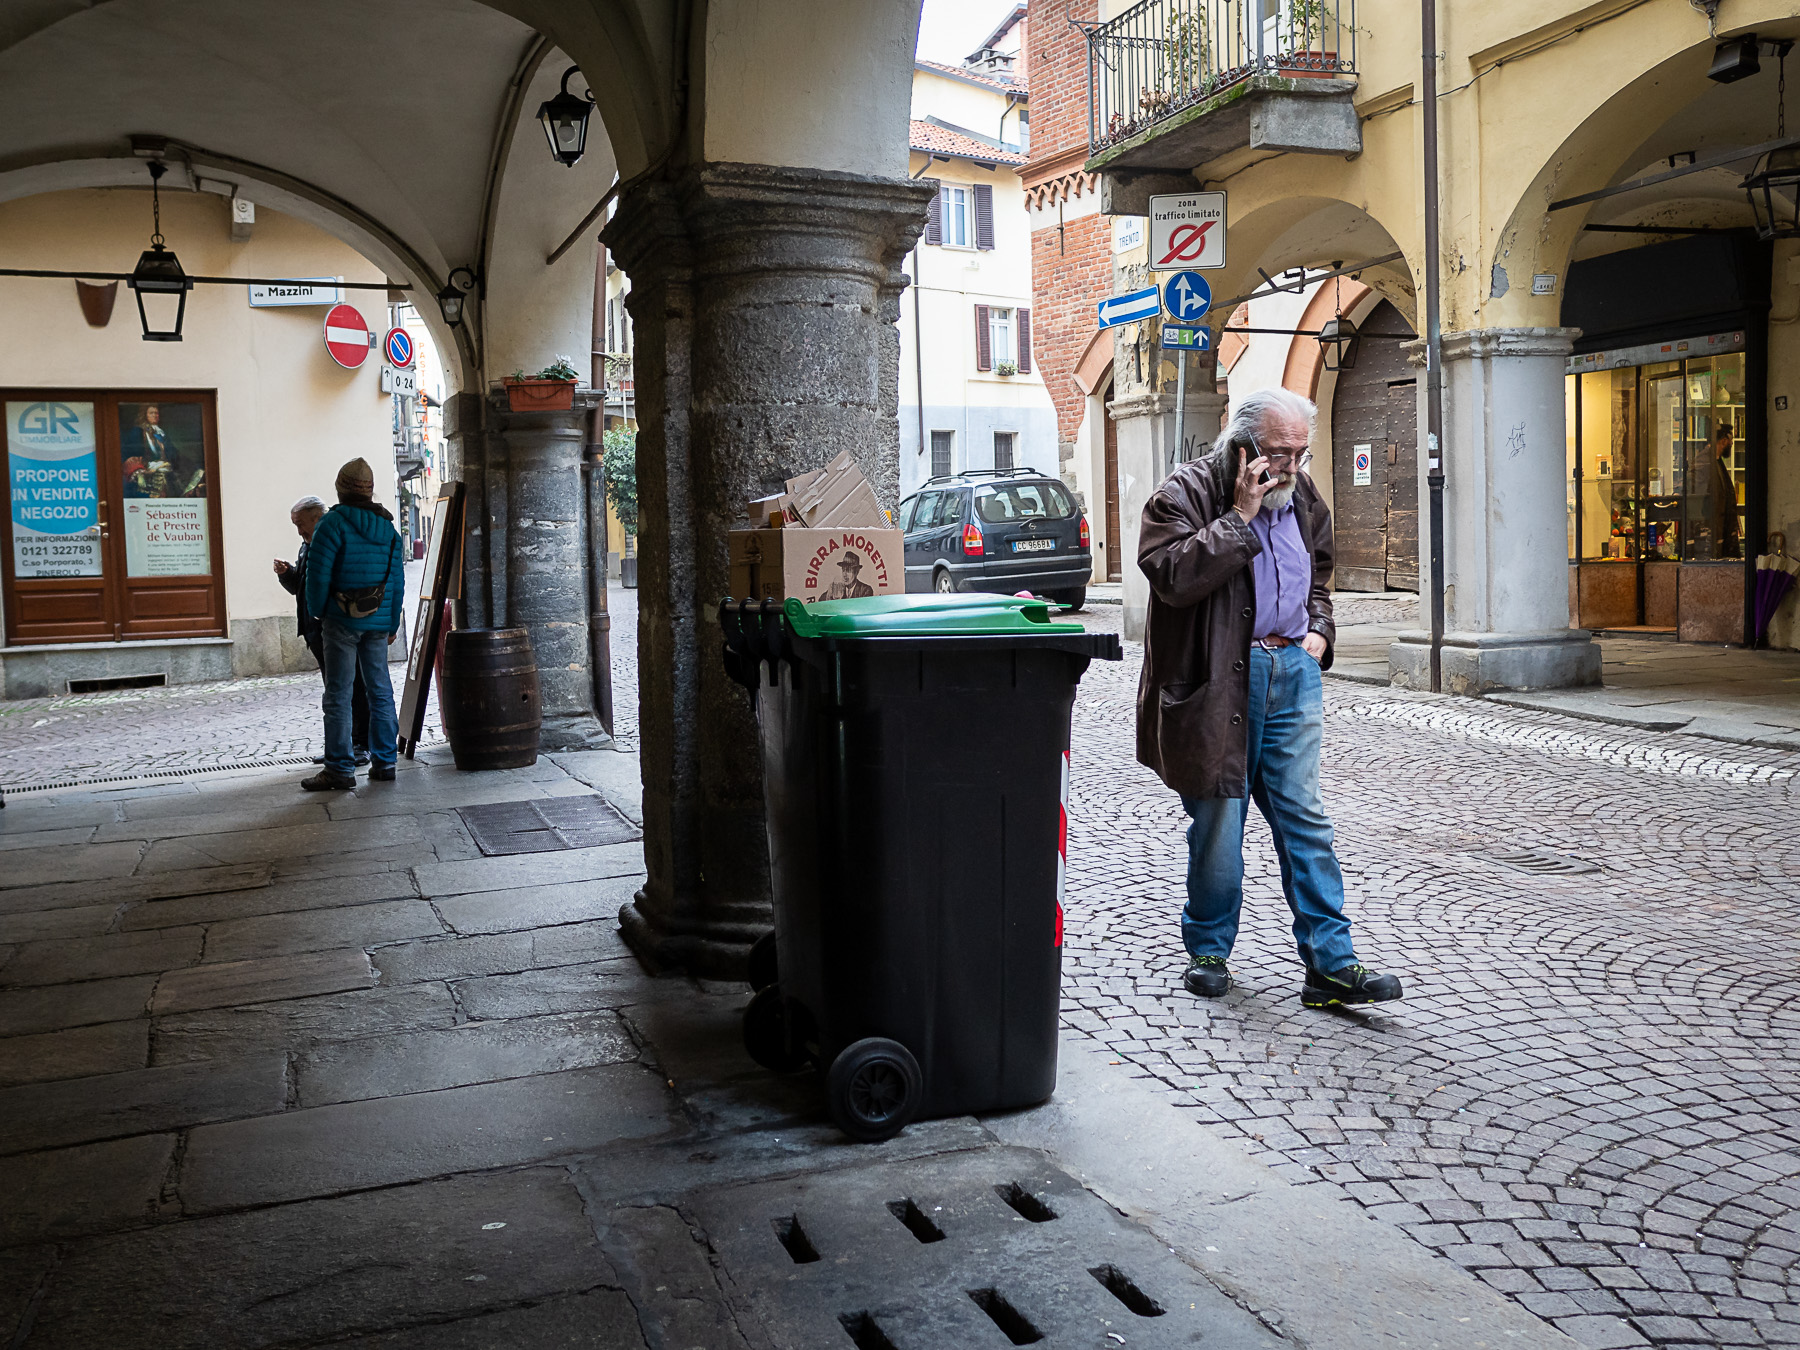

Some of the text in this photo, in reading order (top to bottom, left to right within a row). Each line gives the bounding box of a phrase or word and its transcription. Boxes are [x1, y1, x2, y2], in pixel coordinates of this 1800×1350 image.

[1178, 200, 1197, 208] zona
[1155, 210, 1221, 221] traffico limitato
[1119, 231, 1139, 248] TRENTO
[268, 286, 313, 297] Mazzini
[1182, 332, 1190, 344] 1
[18, 402, 79, 434] GR
[16, 469, 89, 482] PROPONE
[13, 487, 95, 501] IN VENDITA
[21, 506, 88, 519] NEGOZIO
[146, 510, 197, 520] Sébastien
[147, 521, 201, 531] Le Prestre
[35, 535, 98, 543] INFORMAZIONI
[147, 532, 204, 541] de Vauban
[21, 545, 92, 556] 0121 322789
[1017, 541, 1027, 550] CC
[22, 559, 41, 567] C.so
[43, 559, 86, 567] Porporato,
[805, 533, 888, 588] BIRRA MORETTI
[36, 569, 81, 577] PINEROLO
